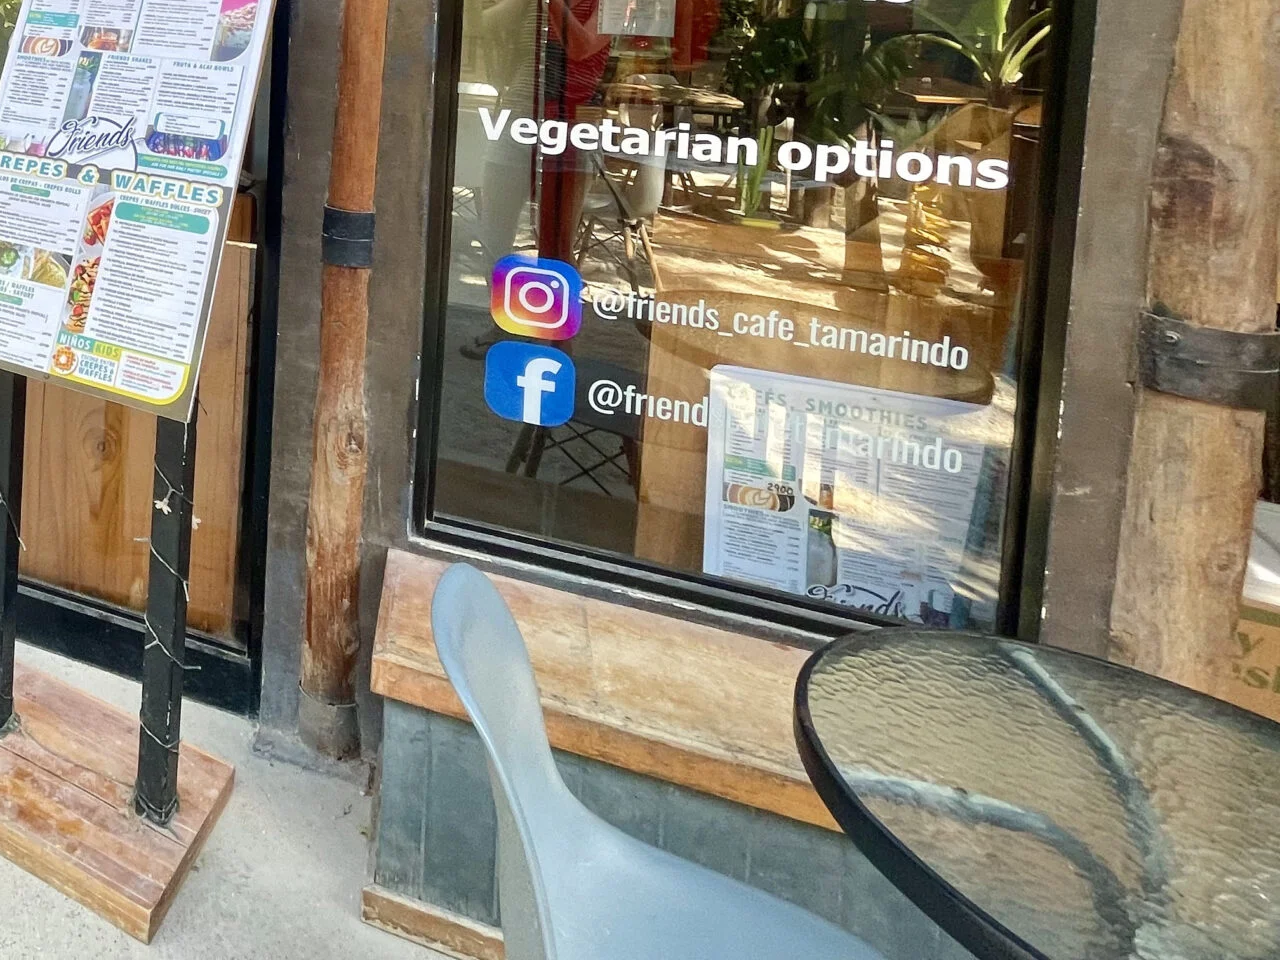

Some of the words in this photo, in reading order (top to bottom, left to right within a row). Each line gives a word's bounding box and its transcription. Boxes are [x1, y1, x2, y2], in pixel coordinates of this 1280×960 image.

[48, 116, 135, 157] Friends
[478, 107, 758, 167] Vegetarian
[776, 137, 1011, 192] options
[80, 169, 96, 184] &
[114, 173, 220, 205] WAFFLES
[144, 198, 169, 208] WAFFLES
[11, 282, 35, 293] WAFFLES
[592, 290, 969, 371] @friends_cafe_tamarindo
[59, 332, 91, 351] NIÑOS
[95, 341, 119, 359] KIDS
[78, 367, 113, 383] WAFFLES
[79, 359, 108, 373] CREPES
[805, 398, 929, 431] SMOOTHIES
[766, 482, 794, 495] 2900
